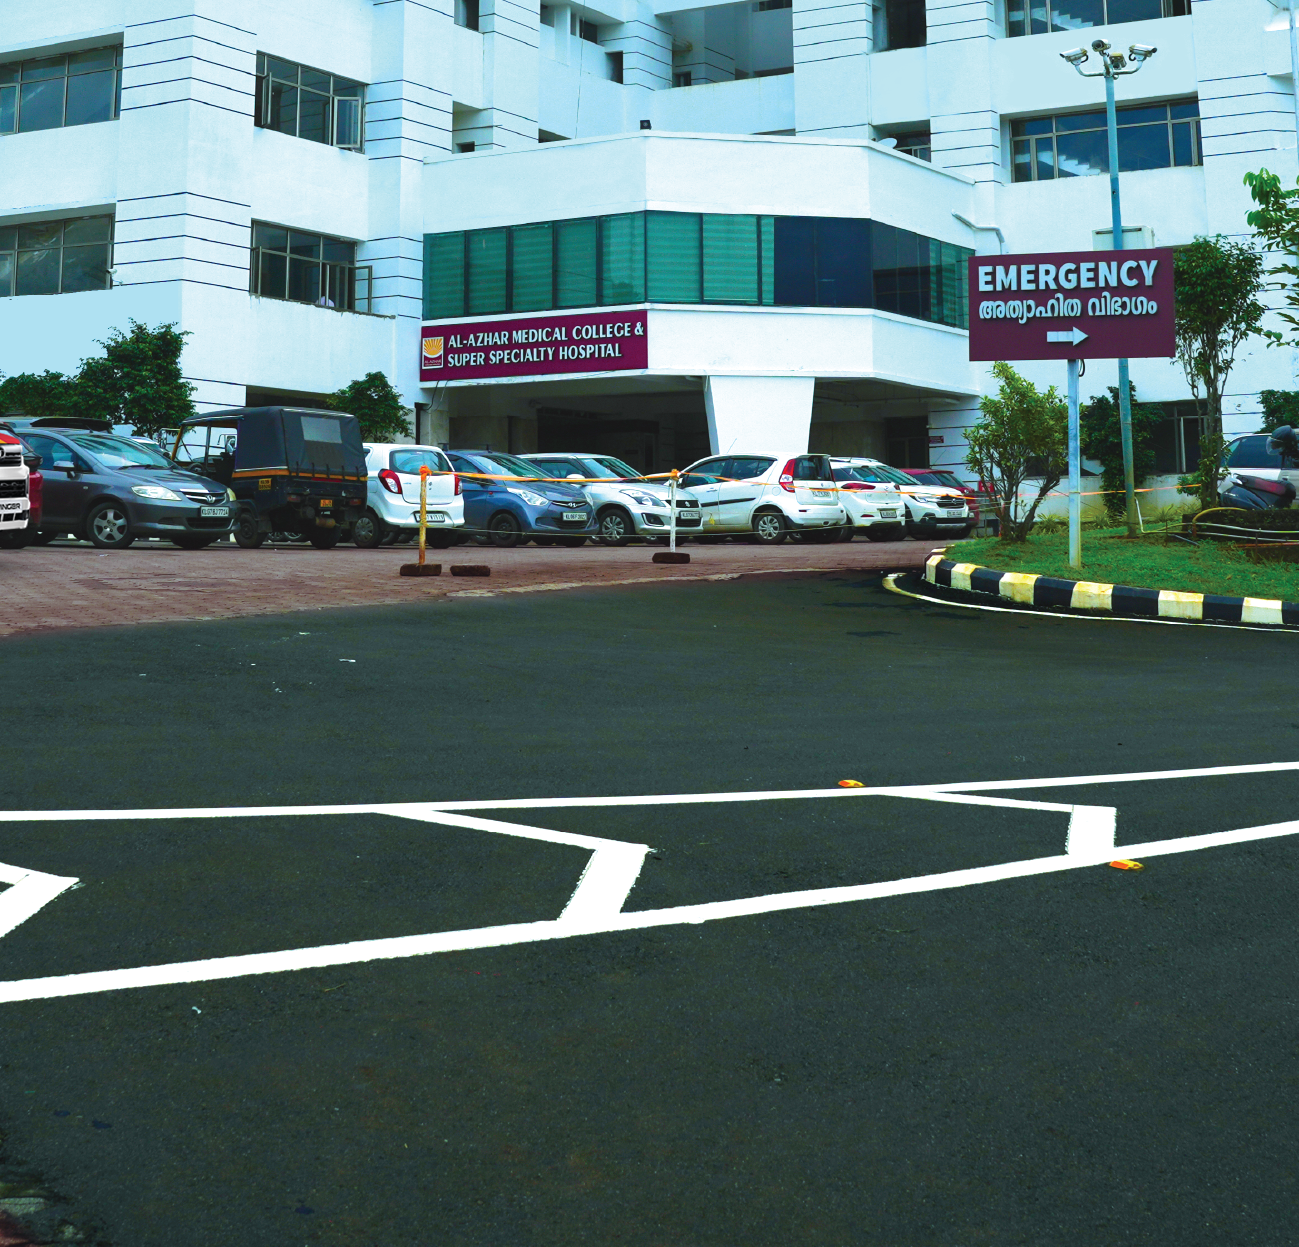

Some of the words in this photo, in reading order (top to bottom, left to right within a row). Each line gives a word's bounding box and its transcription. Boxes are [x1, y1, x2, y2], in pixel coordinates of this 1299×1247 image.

[978, 259, 1159, 292] EMERGENCY
[979, 292, 1082, 324] അത്യാഹിത
[1087, 291, 1158, 316] വിഭാഗം
[448, 331, 509, 349] AL-AZHAR
[512, 327, 568, 344] MEDICAL
[572, 322, 631, 340] COLLEGE
[634, 321, 644, 336] &
[448, 352, 485, 367] SUPER
[489, 347, 556, 364] SPECIALTY
[559, 343, 622, 360] HOSPITAL
